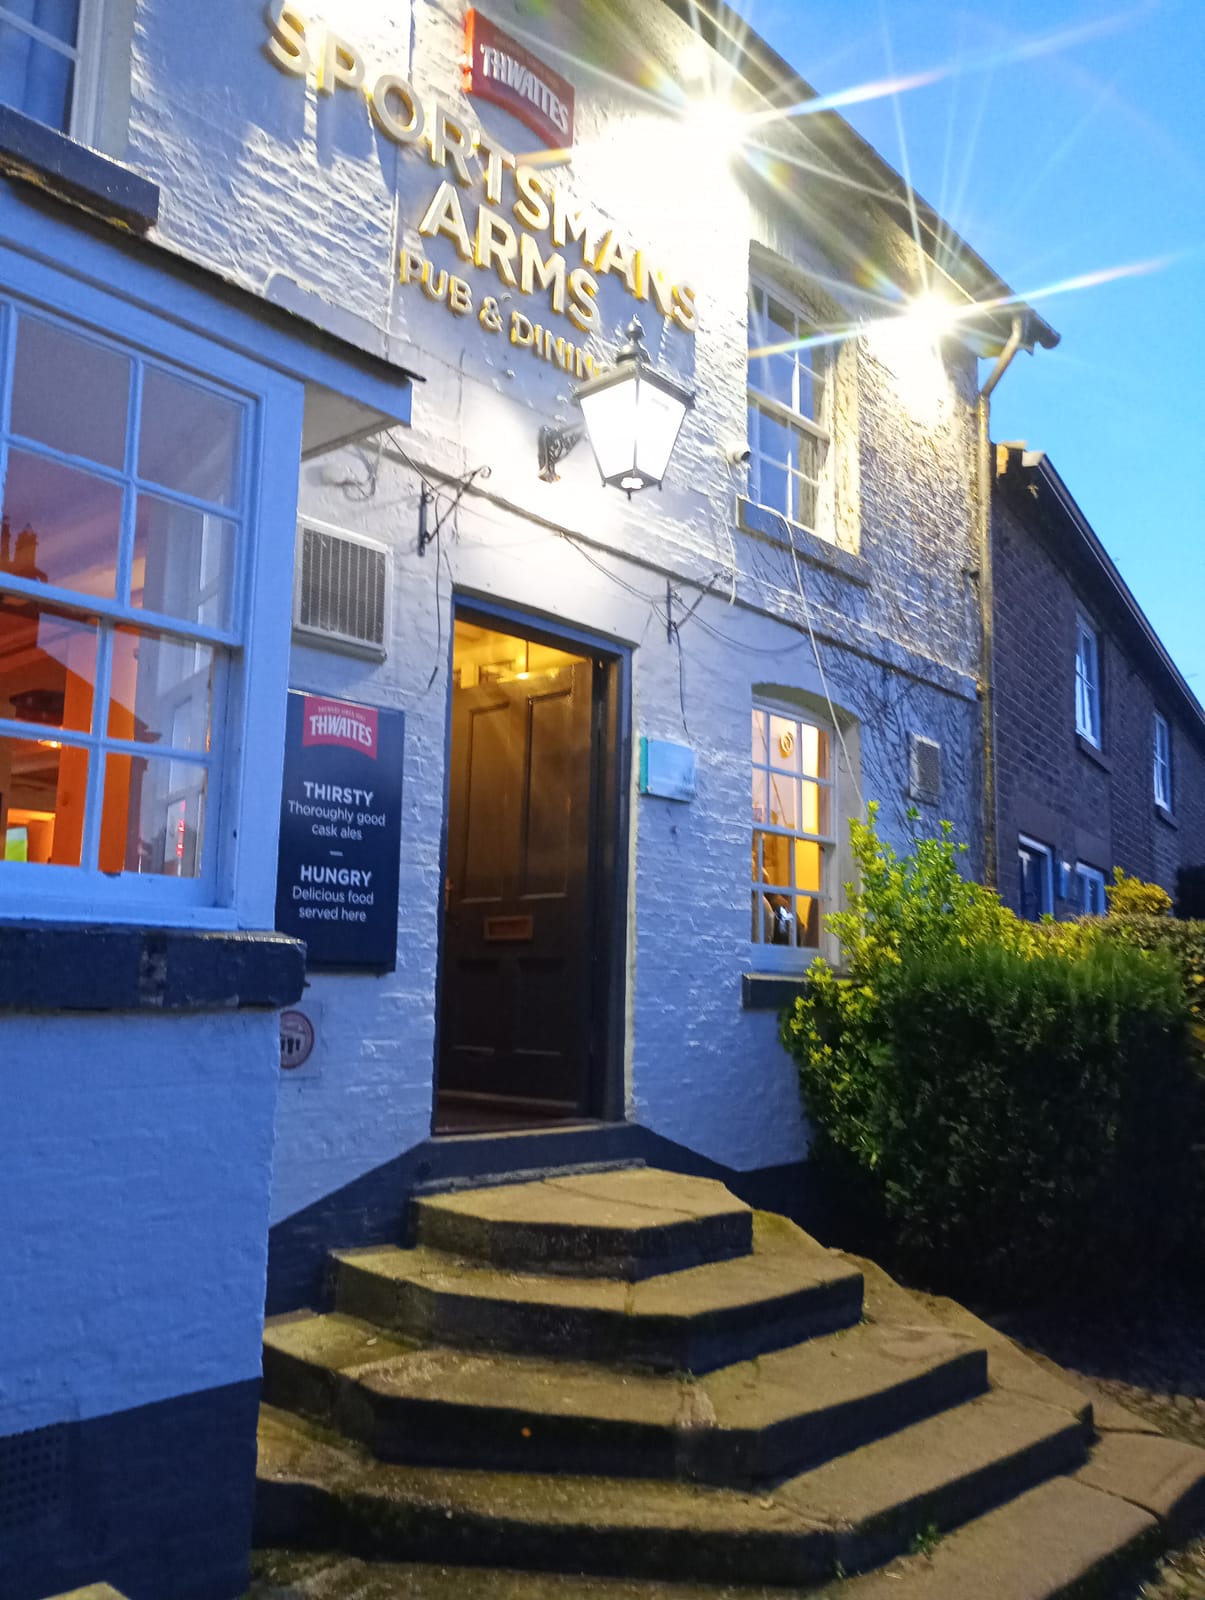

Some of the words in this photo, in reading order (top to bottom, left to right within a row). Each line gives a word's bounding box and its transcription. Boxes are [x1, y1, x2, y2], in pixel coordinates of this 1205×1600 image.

[480, 43, 569, 135] THWAITES
[262, 0, 699, 332] SPORTSMANS
[419, 180, 601, 334] ARMS
[400, 250, 473, 314] PUB
[480, 296, 504, 333] &
[309, 713, 373, 748] THWAITES
[303, 781, 374, 807] THIRSTY
[287, 799, 354, 825] Thoroughly
[357, 812, 387, 827] good
[311, 823, 338, 838] cask
[339, 827, 362, 841] ales
[300, 864, 372, 888] HUNGRY
[292, 885, 345, 904] Delicious
[347, 889, 375, 905] food
[298, 906, 339, 920] served
[341, 907, 367, 922] here
